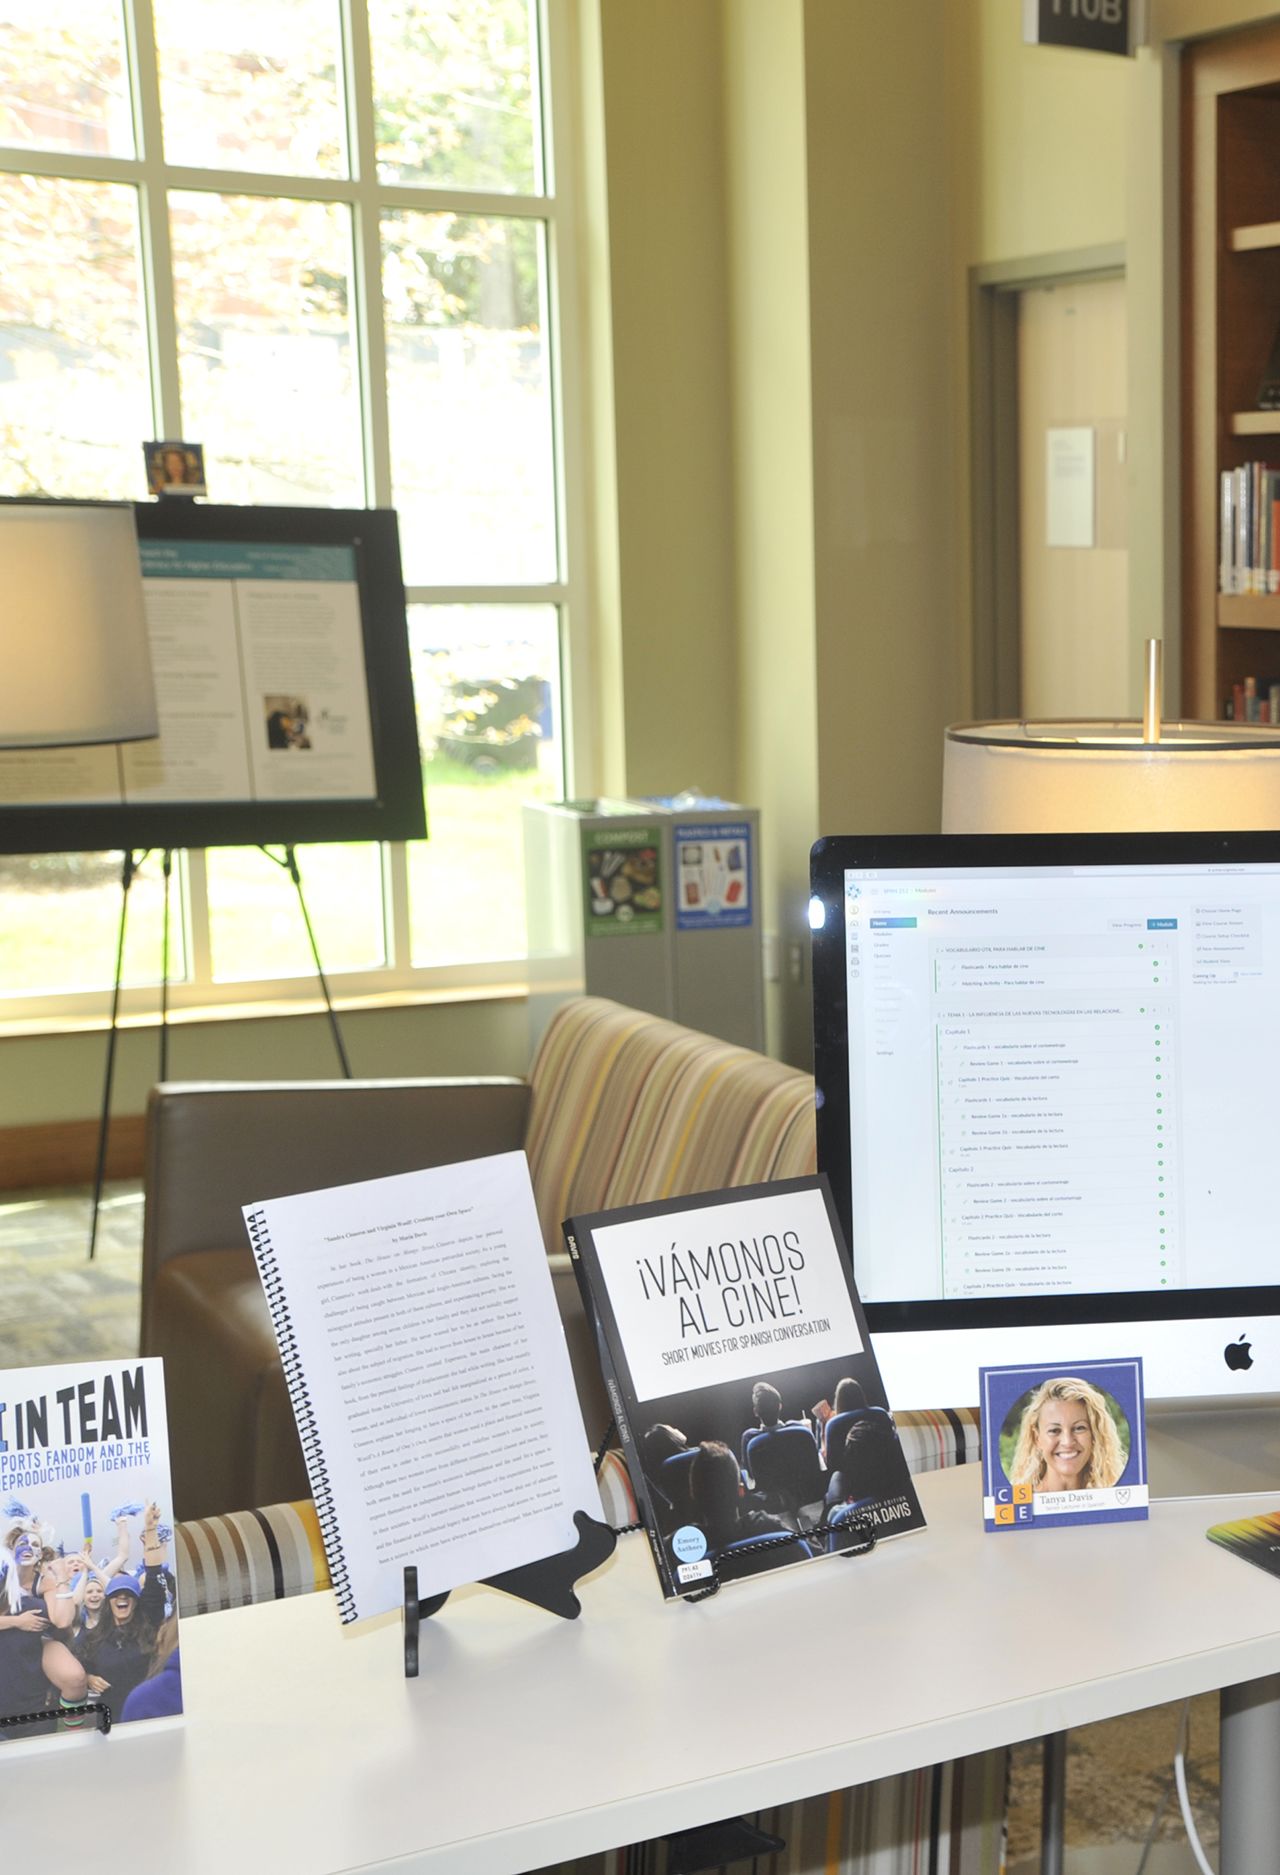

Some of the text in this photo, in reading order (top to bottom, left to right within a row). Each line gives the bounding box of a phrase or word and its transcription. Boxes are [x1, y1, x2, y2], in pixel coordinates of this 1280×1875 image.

[636, 1231, 806, 1300] ¡VÁMONOS
[679, 1275, 804, 1339] AL CINE!
[661, 1318, 831, 1367] SHORT MOVIES FOR SPANISH CONVERSATION
[15, 1395, 49, 1450] IN
[56, 1365, 148, 1445] TEAM
[0, 1441, 150, 1474] PORTS FANDOM AND THE
[0, 1454, 151, 1492] EPRODUCTION OF IDENTITY
[881, 1502, 911, 1523] DAVIS
[998, 1488, 1027, 1502] C S
[1040, 1492, 1094, 1506] Tanya Davis
[1000, 1506, 1028, 1521] C E
